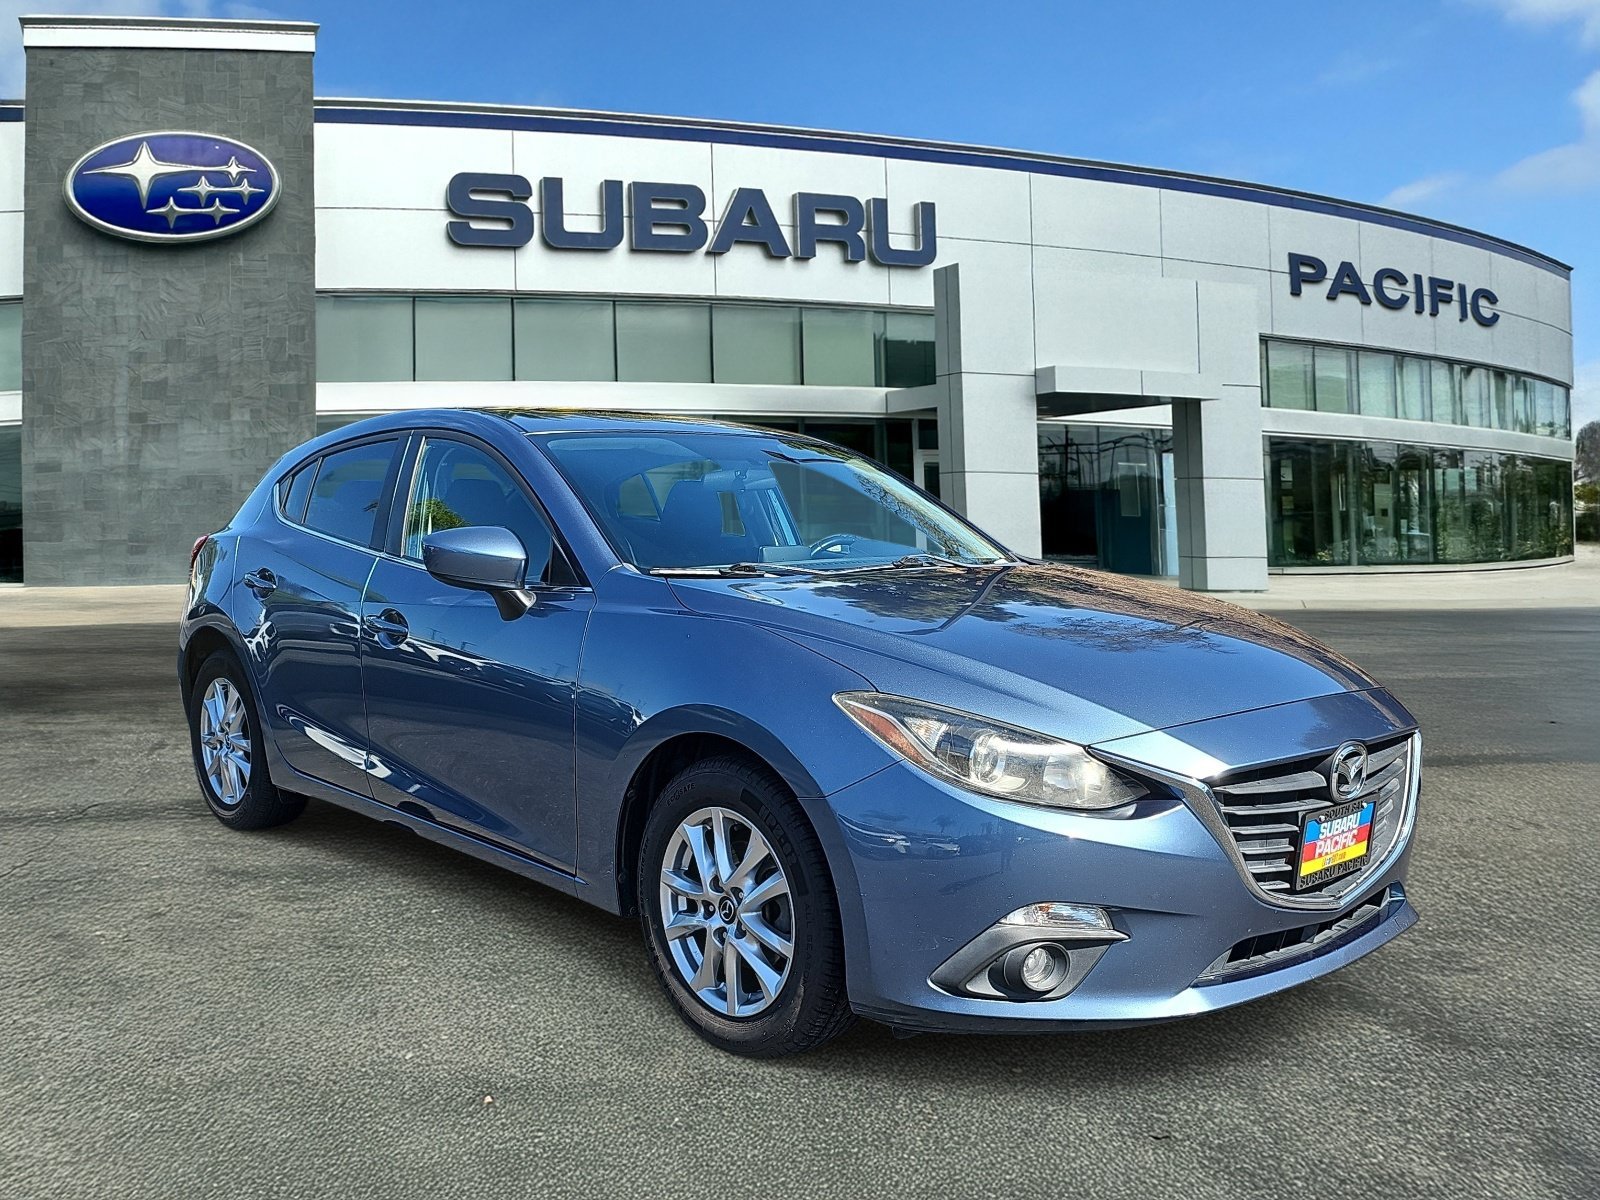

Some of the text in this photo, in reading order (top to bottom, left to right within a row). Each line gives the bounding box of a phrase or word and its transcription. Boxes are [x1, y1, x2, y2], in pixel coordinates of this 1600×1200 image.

[446, 171, 937, 269] SUBARU
[1288, 252, 1500, 327] PACIFIC
[1319, 812, 1361, 839] SUBARU
[1324, 805, 1351, 819] SOUTH
[1315, 830, 1358, 858] PACIFIC
[1300, 867, 1336, 888] SUBARU
